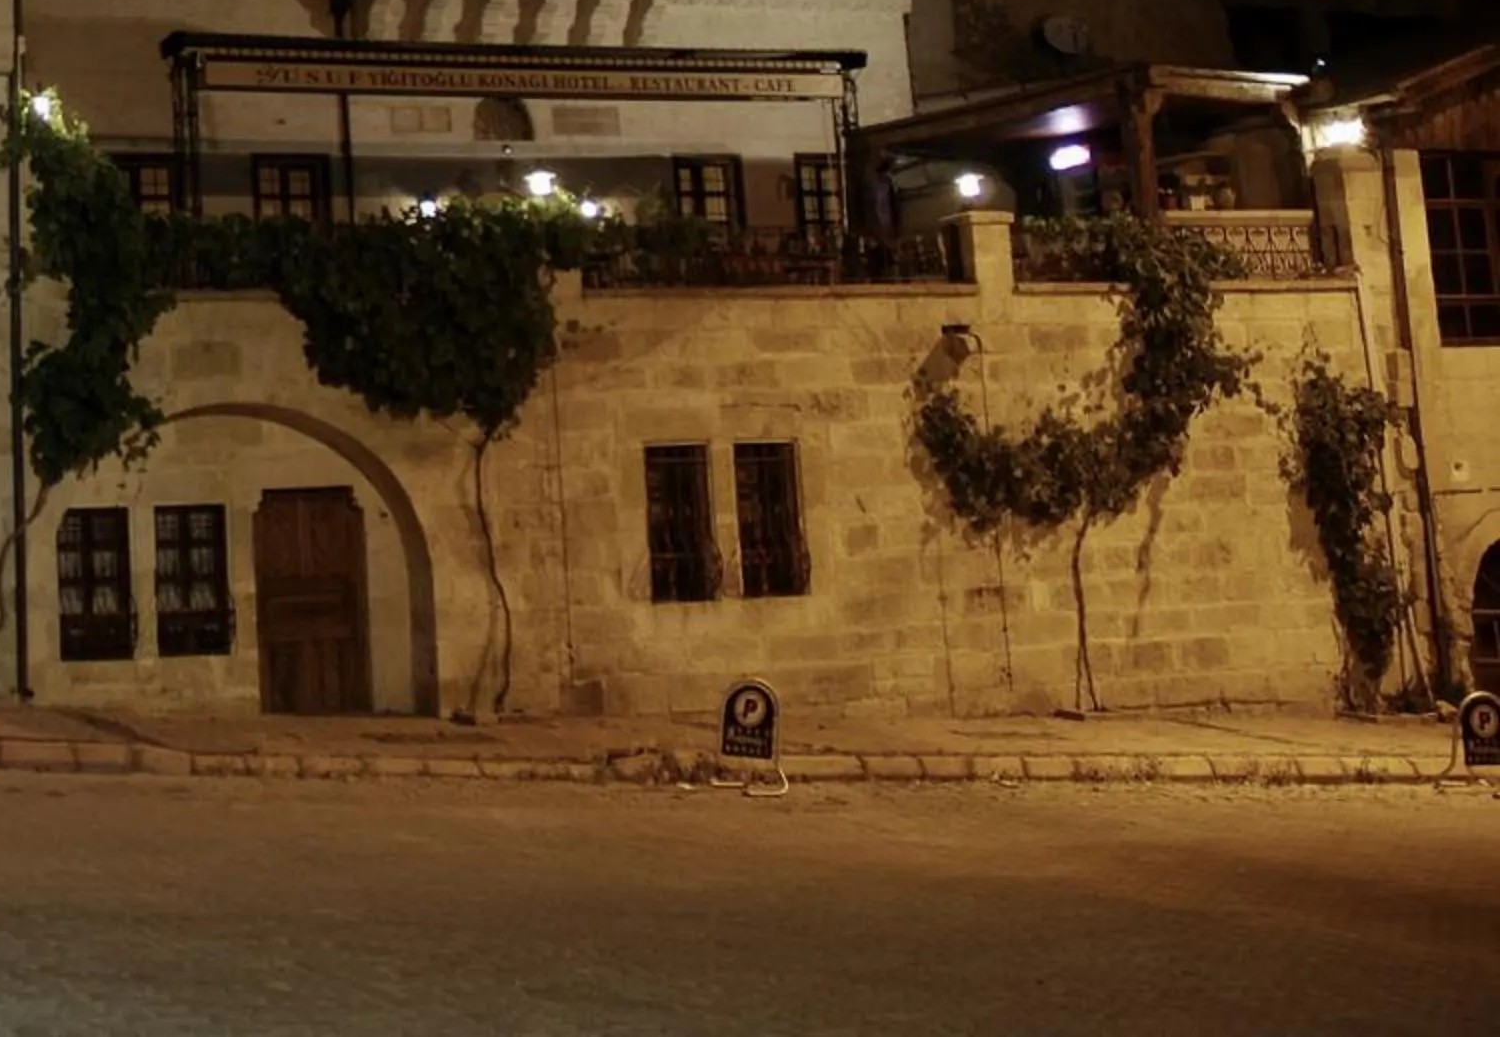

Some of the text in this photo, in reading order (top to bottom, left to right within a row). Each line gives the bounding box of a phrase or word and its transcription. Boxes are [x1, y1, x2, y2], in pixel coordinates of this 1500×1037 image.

[553, 74, 613, 90] HOTEL
[629, 75, 740, 92] RESTAURANT
[742, 698, 758, 720] P
[1478, 710, 1491, 731] P
